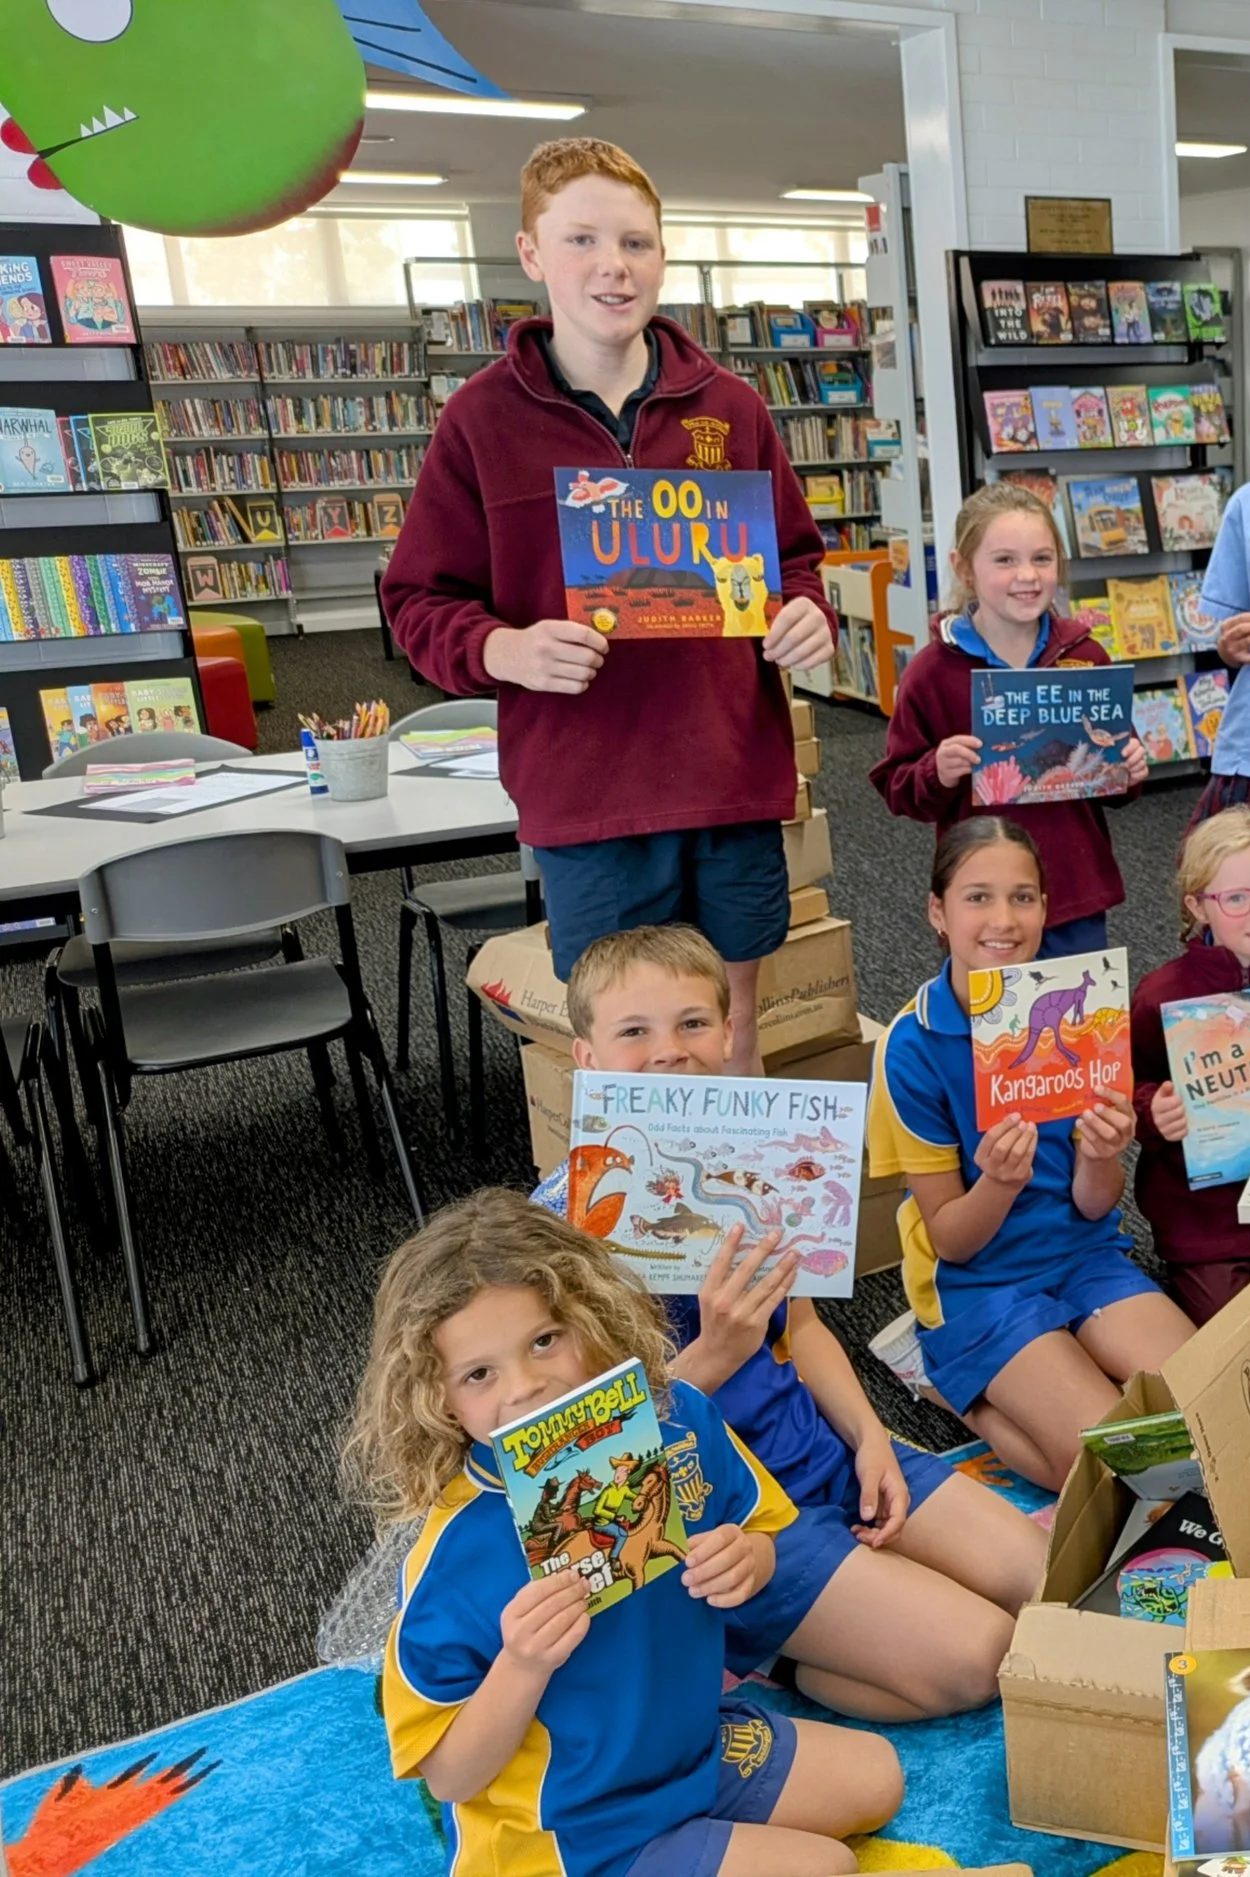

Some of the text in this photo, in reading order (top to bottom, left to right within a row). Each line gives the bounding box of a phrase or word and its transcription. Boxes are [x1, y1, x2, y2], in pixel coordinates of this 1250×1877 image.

[995, 308, 1023, 318] INTO
[1000, 319, 1022, 328] THE
[997, 331, 1028, 341] WILD
[608, 479, 729, 519] THE OO IN
[255, 511, 272, 527] U
[328, 507, 342, 523] Y
[383, 506, 398, 523] Z
[592, 520, 748, 565] ULURU
[195, 570, 214, 586] W
[1004, 685, 1111, 705] THE EE IN THE
[983, 704, 1124, 726] DEEP BLUE SEA
[520, 989, 558, 1017] Harper
[1231, 1043, 1245, 1059] a
[991, 1067, 1084, 1106] Kangaroos
[601, 1084, 694, 1116] FREAKY
[702, 1087, 779, 1118] FUNKY
[788, 1092, 839, 1121] FISH
[648, 1122, 788, 1138] Odd Facts about Fascinating Fish
[1178, 1518, 1207, 1541] We
[540, 1551, 570, 1575] The
[1176, 1659, 1188, 1671] 3
